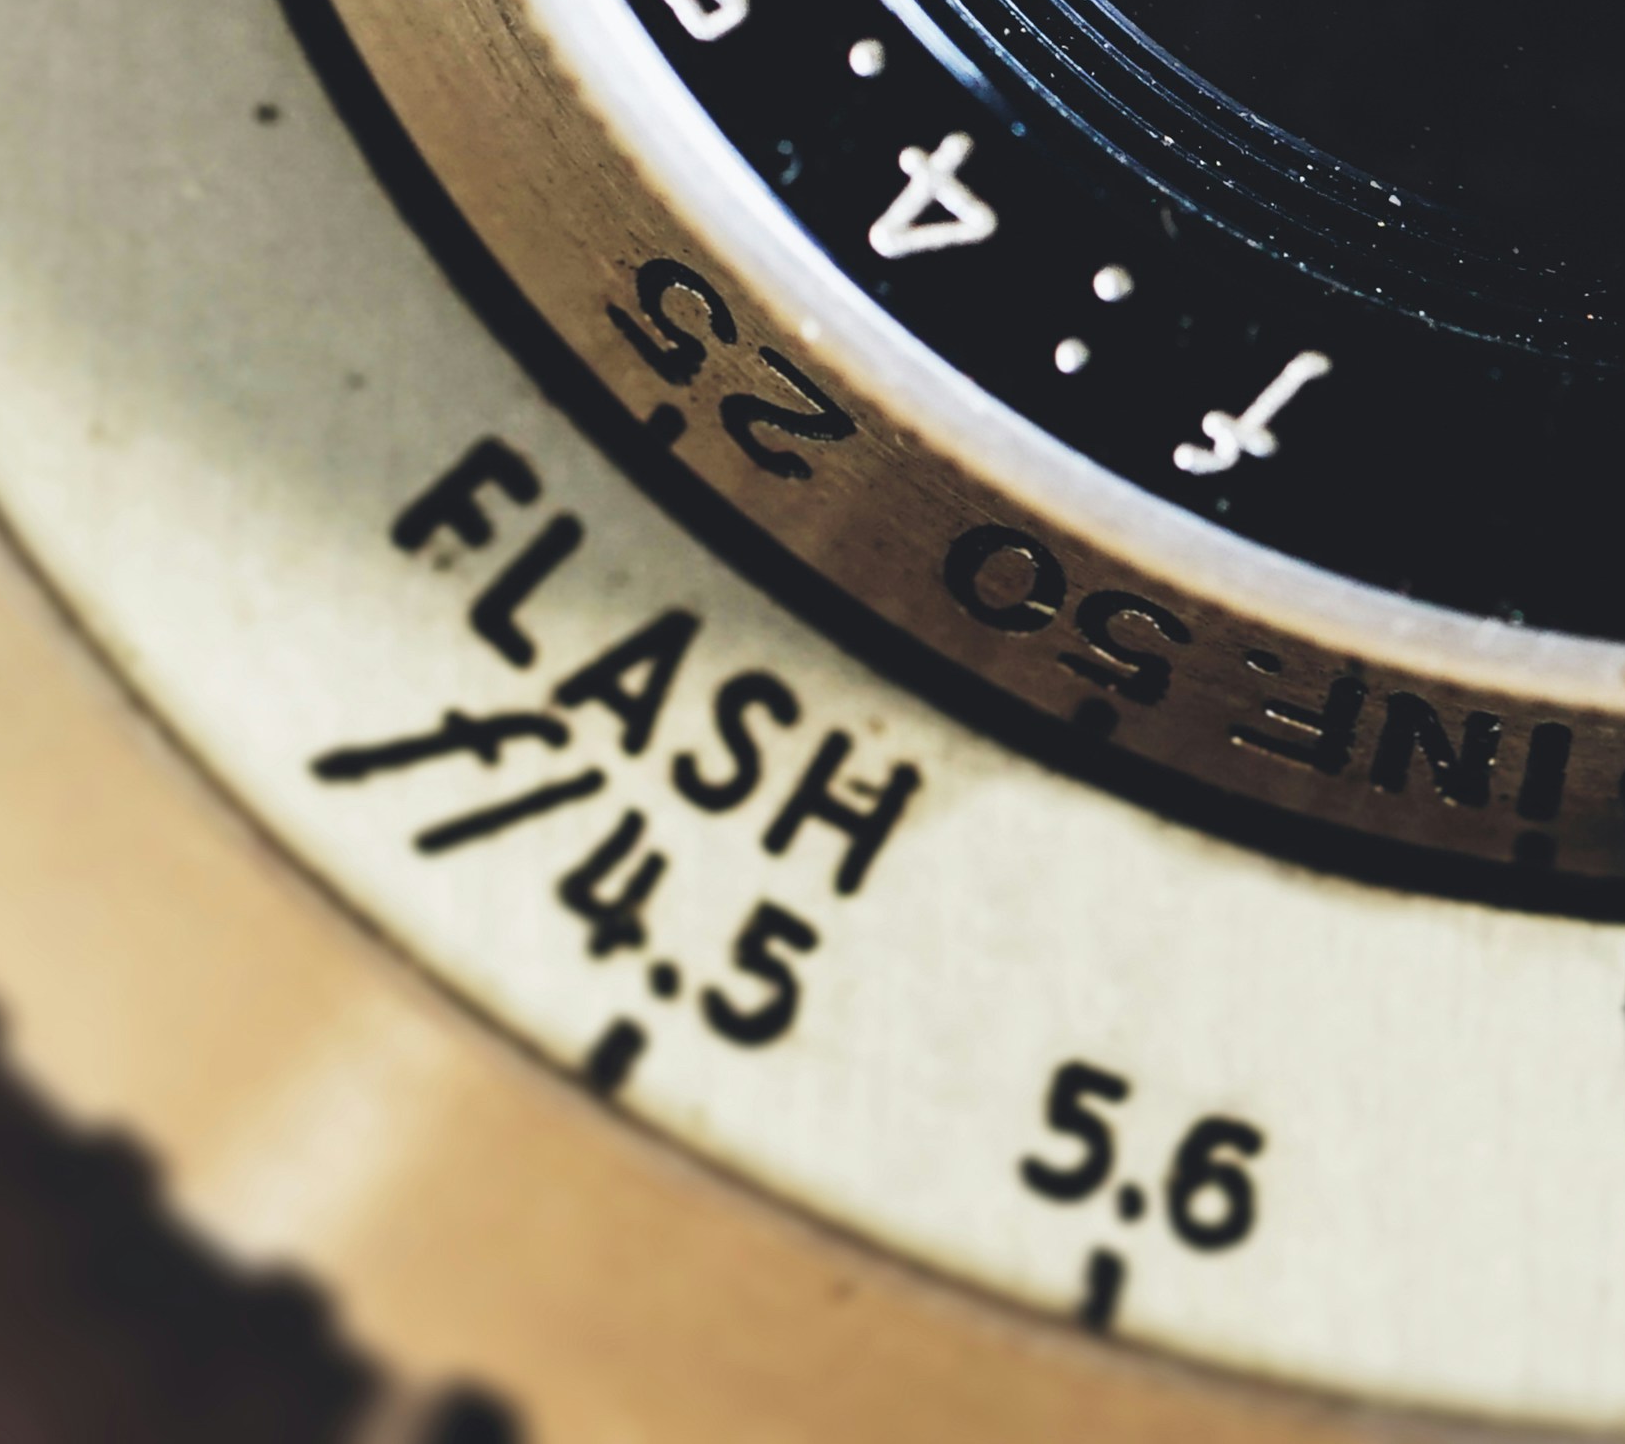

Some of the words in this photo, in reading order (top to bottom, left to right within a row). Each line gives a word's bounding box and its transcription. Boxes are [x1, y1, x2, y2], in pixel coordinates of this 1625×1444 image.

[603, 256, 859, 483] 25
[390, 433, 922, 899] FLASH
[942, 523, 1190, 705] 50
[1019, 1059, 1265, 1255] 5.6
